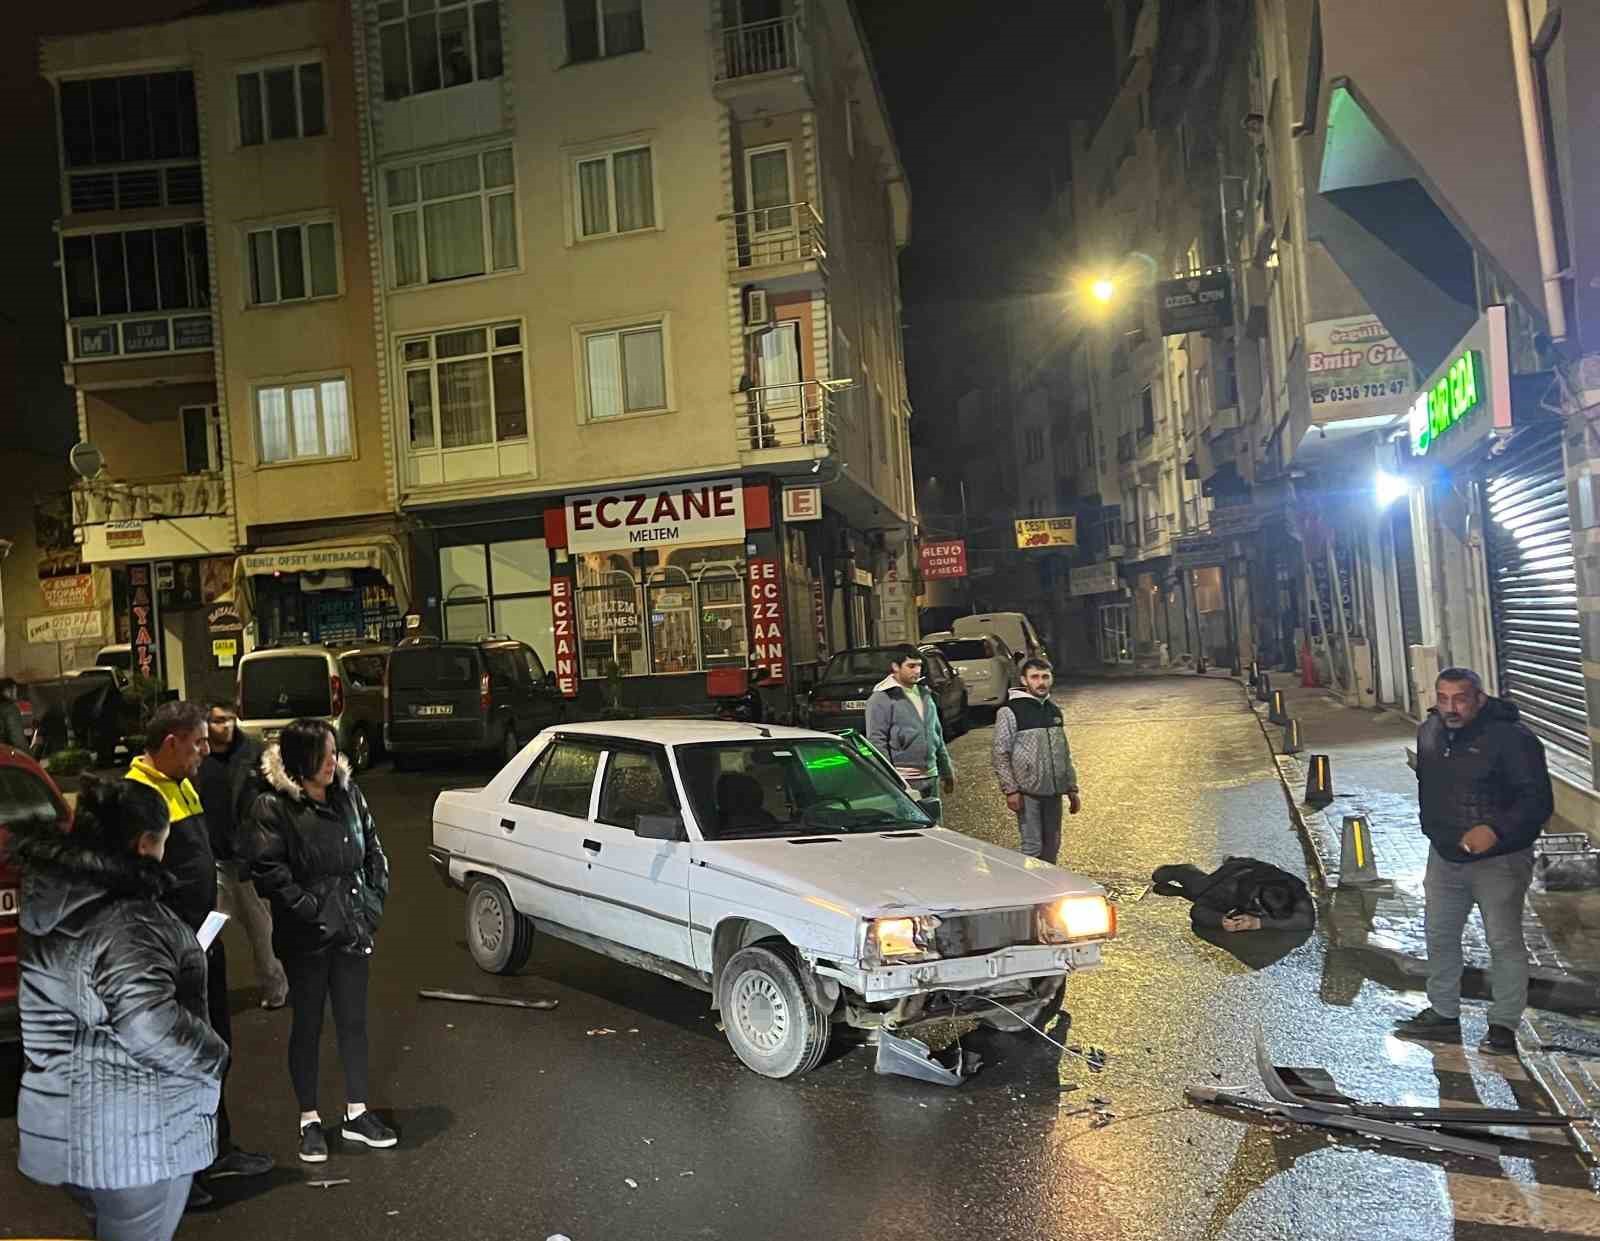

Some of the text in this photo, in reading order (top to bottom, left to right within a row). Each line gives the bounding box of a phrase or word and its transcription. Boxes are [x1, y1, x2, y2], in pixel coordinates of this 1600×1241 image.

[573, 484, 736, 531] ECZANE
[629, 527, 679, 543] MELTEM
[792, 491, 811, 512] E
[552, 582, 574, 694] ECZANE
[750, 564, 767, 668] ECZAN
[763, 563, 784, 678] ECZANE
